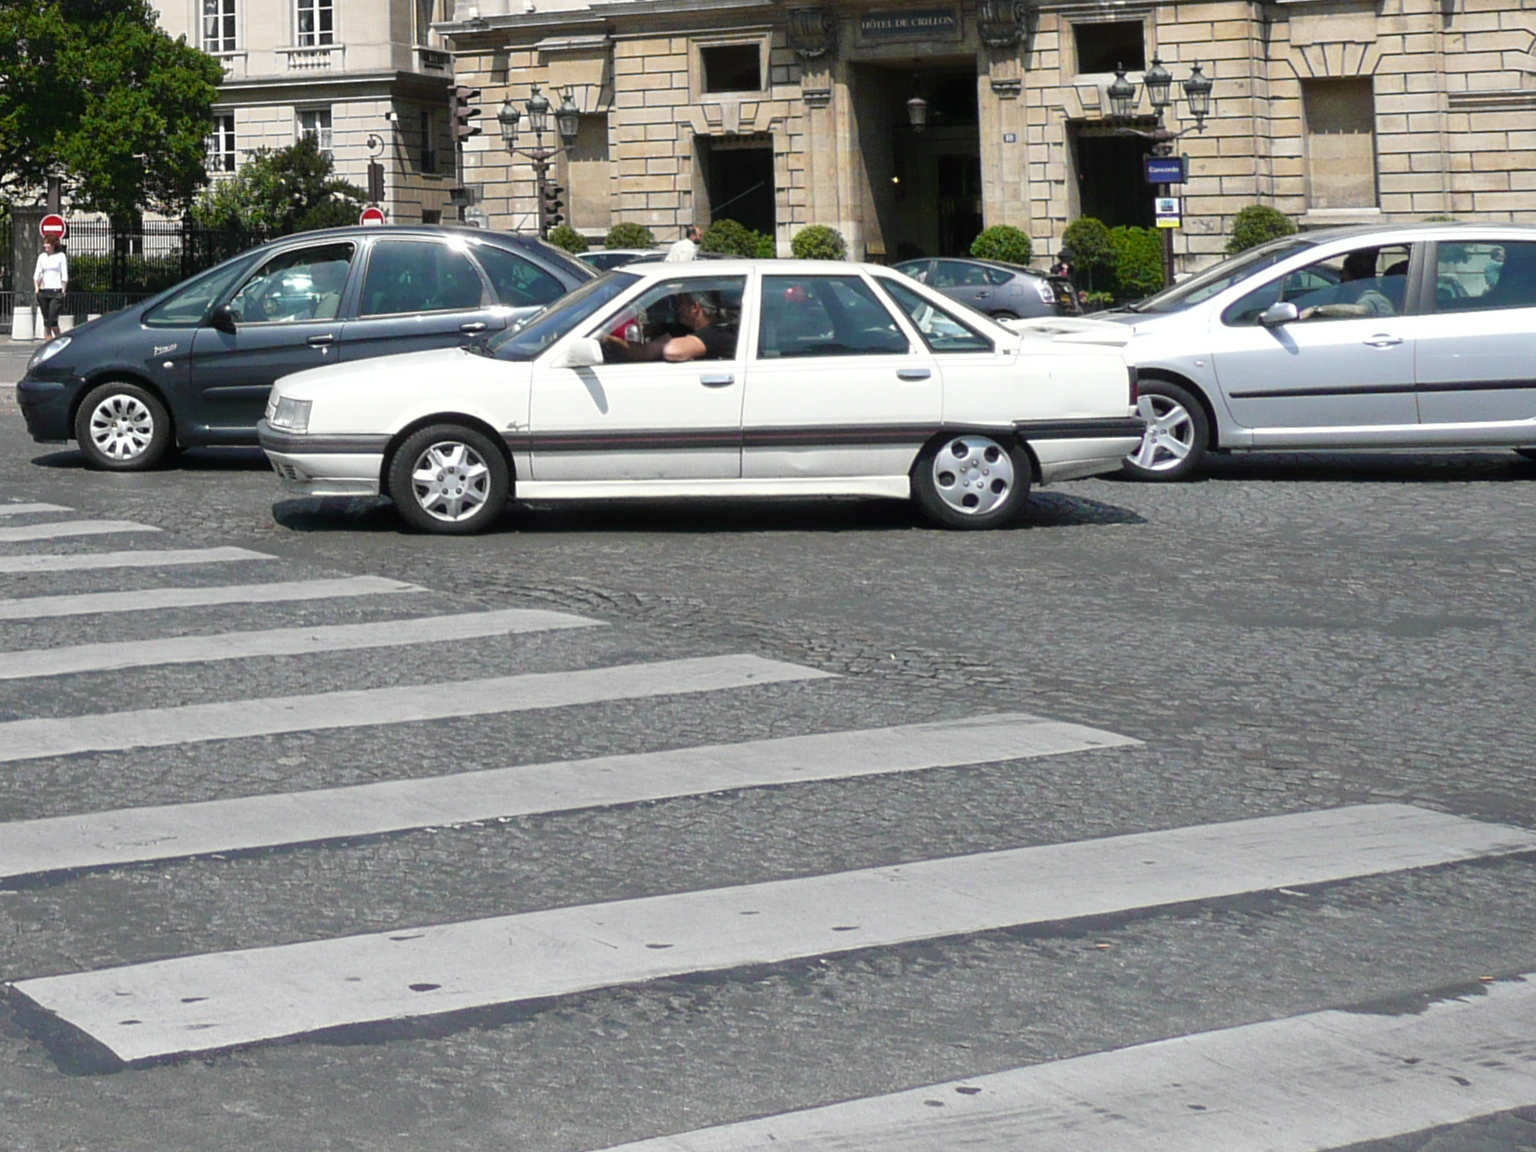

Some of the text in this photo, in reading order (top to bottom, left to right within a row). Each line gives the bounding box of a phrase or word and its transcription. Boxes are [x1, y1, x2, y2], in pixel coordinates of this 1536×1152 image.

[861, 16, 954, 29] HÔTEL DE CRILLON
